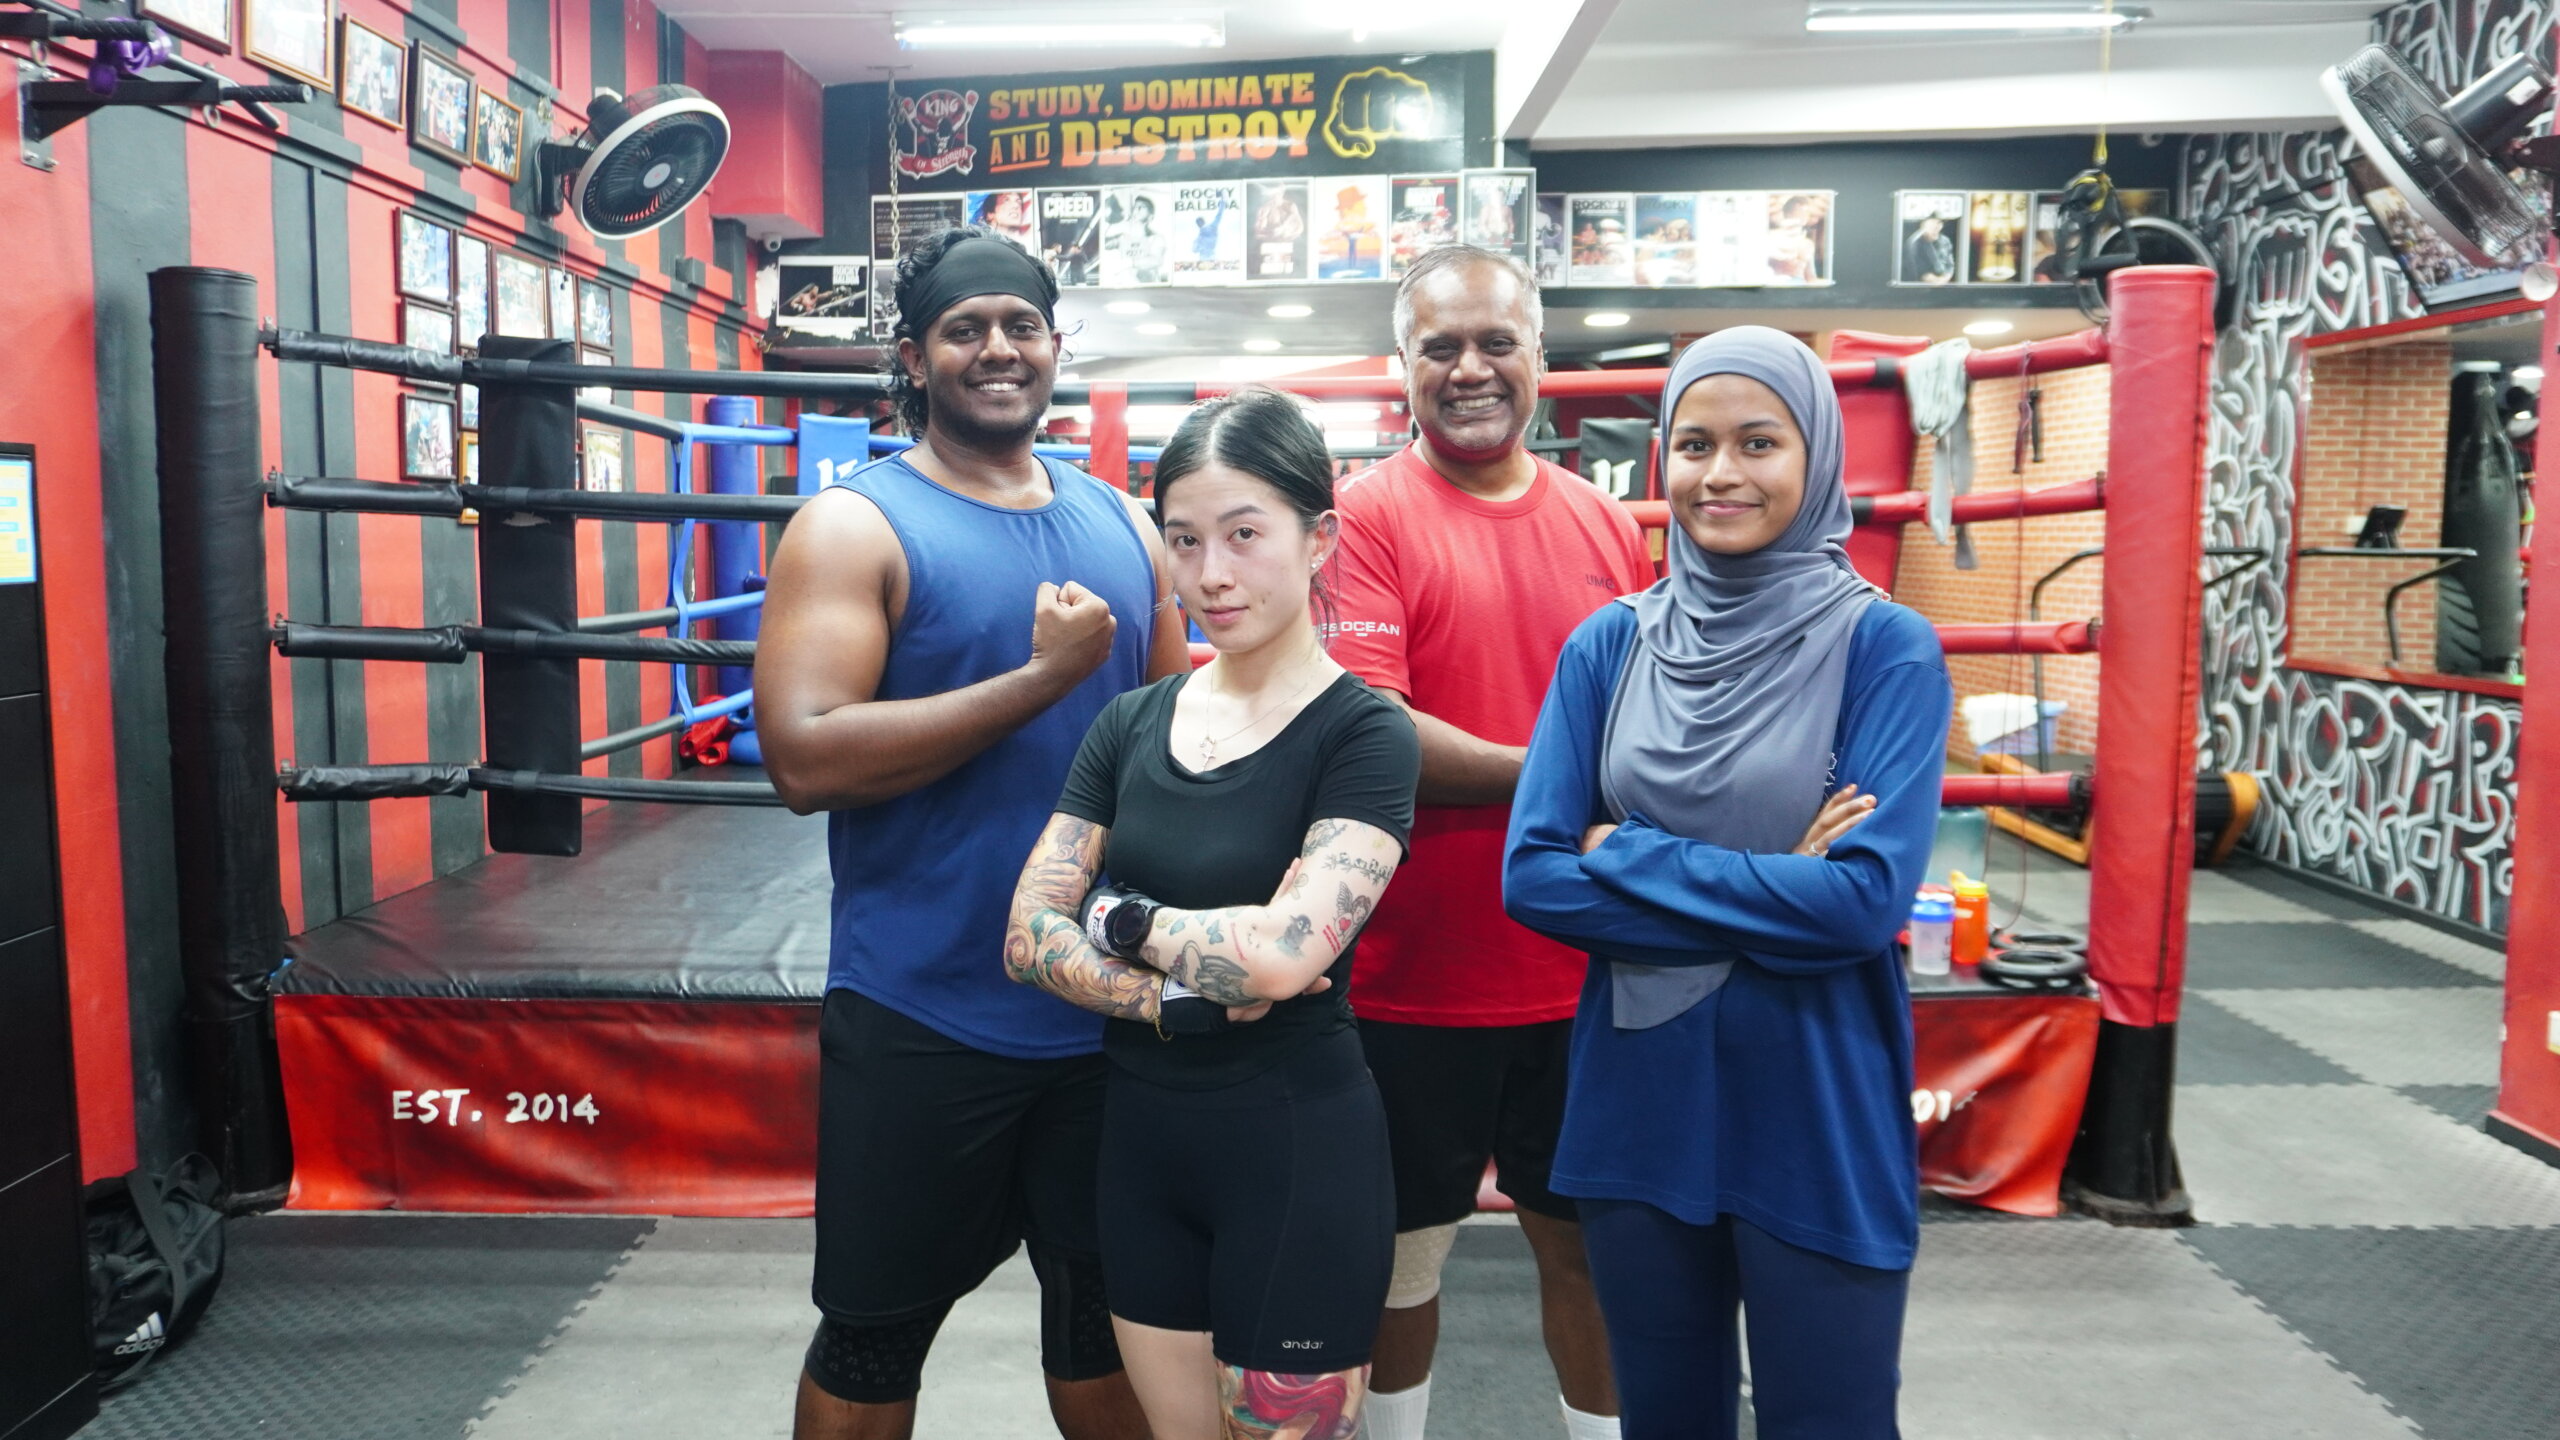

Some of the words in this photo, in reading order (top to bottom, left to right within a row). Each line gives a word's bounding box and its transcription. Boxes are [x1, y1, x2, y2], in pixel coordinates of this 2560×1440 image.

[989, 83, 1114, 120] STUDY,
[1122, 72, 1315, 113] DOMINATE
[925, 99, 958, 117] KING
[990, 131, 1049, 165] AND
[1060, 109, 1316, 168] DESTROY
[930, 147, 969, 170] Strength
[1181, 188, 1234, 200] ROCKY
[1043, 195, 1095, 219] CREED
[1175, 200, 1239, 212] BALBOA
[1573, 200, 1615, 210] ROCKY
[1341, 620, 1401, 637] OCEAN
[392, 1088, 483, 1127] EST.
[505, 1091, 600, 1125] 2014
[1281, 1339, 1324, 1350] andar
